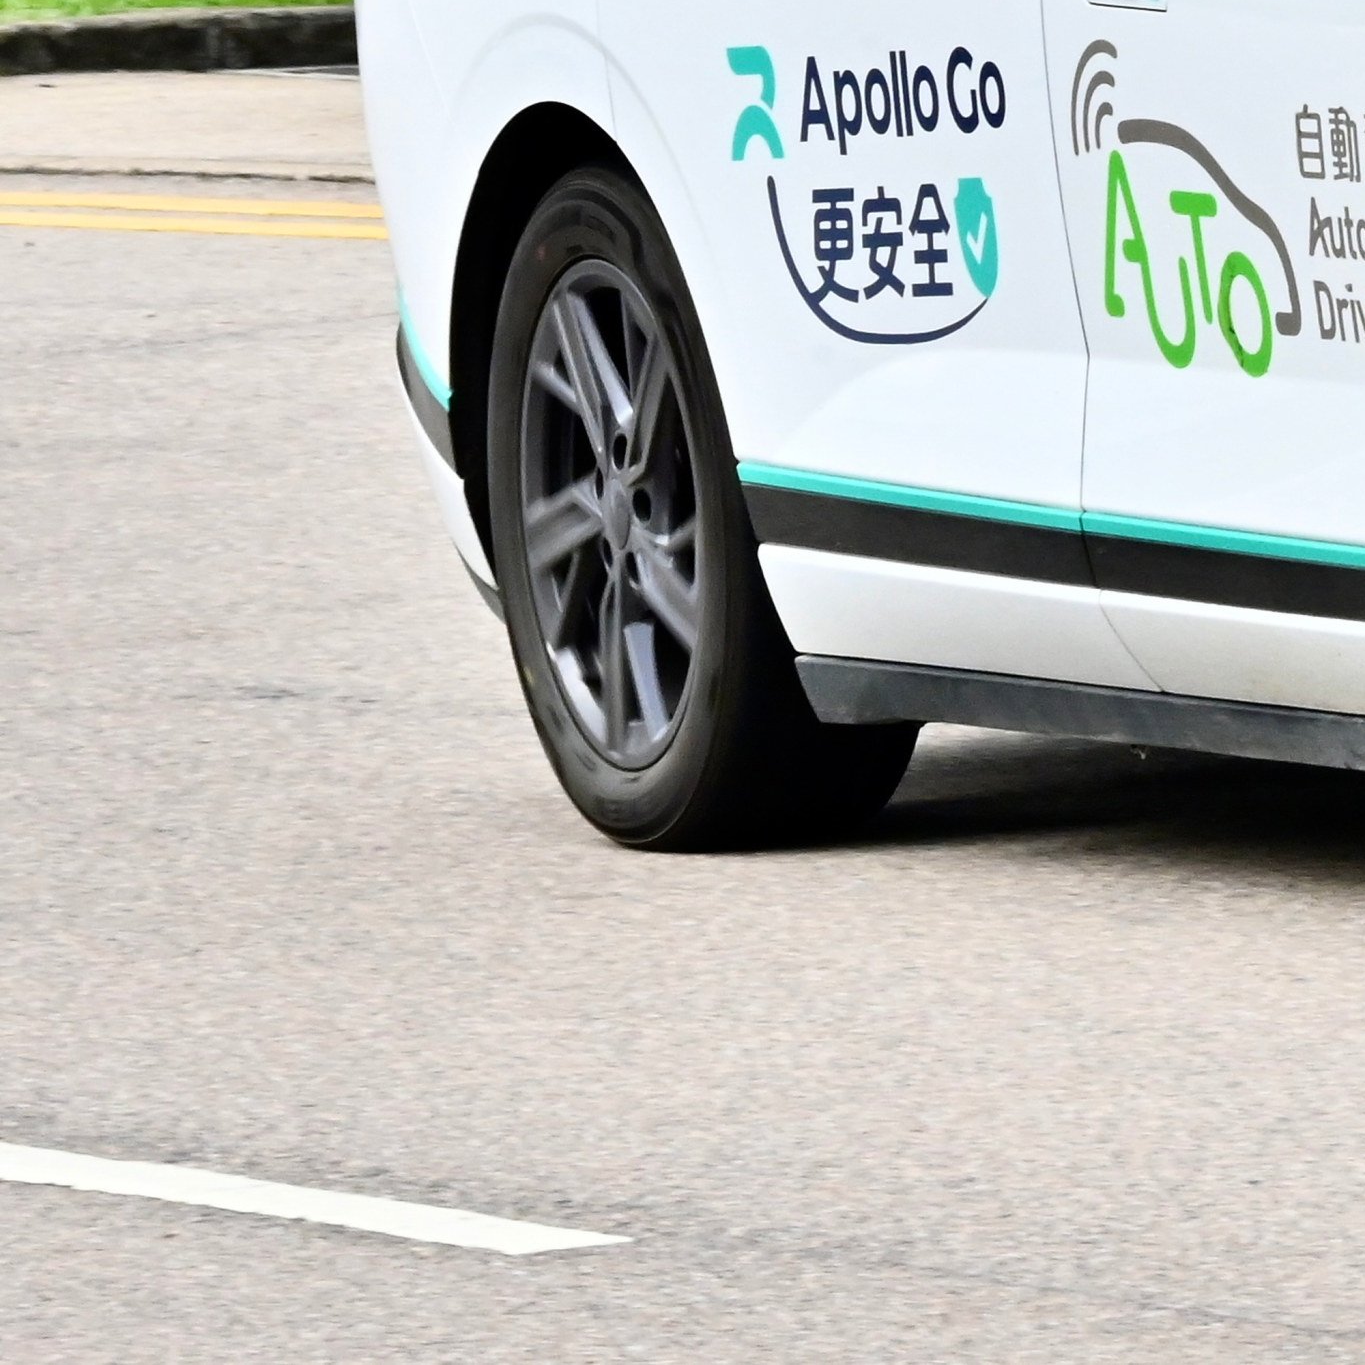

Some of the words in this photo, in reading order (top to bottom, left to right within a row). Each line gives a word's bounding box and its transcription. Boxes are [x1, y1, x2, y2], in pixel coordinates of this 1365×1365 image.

[801, 51, 940, 155] Apollo
[947, 46, 1006, 134] Go
[811, 183, 955, 304] 更安全
